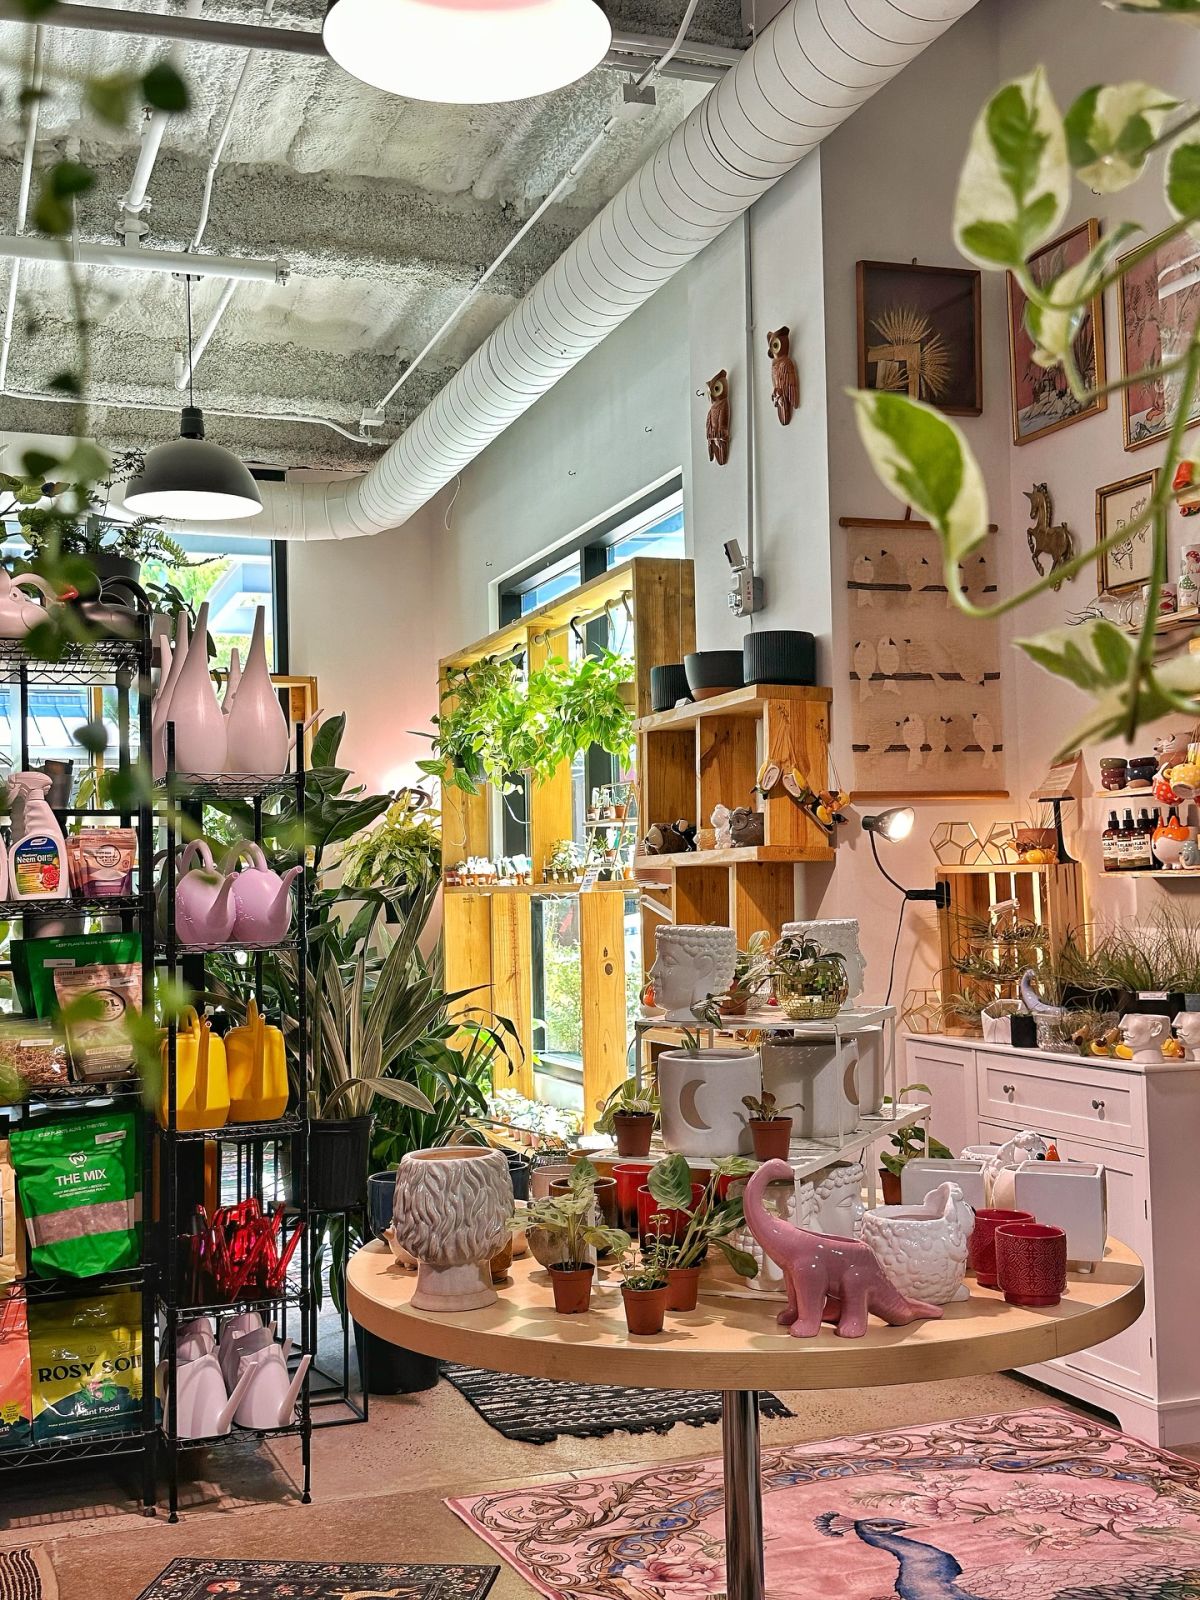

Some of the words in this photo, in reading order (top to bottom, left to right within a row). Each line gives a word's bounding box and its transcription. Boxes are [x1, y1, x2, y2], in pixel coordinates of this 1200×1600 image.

[16, 856, 36, 864] Neem
[37, 854, 47, 862] Oil
[55, 1173, 81, 1187] THE
[83, 1168, 107, 1182] MIX
[38, 1362, 95, 1383] ROSY
[76, 1408, 97, 1418] Pant
[99, 1404, 120, 1413] Food
